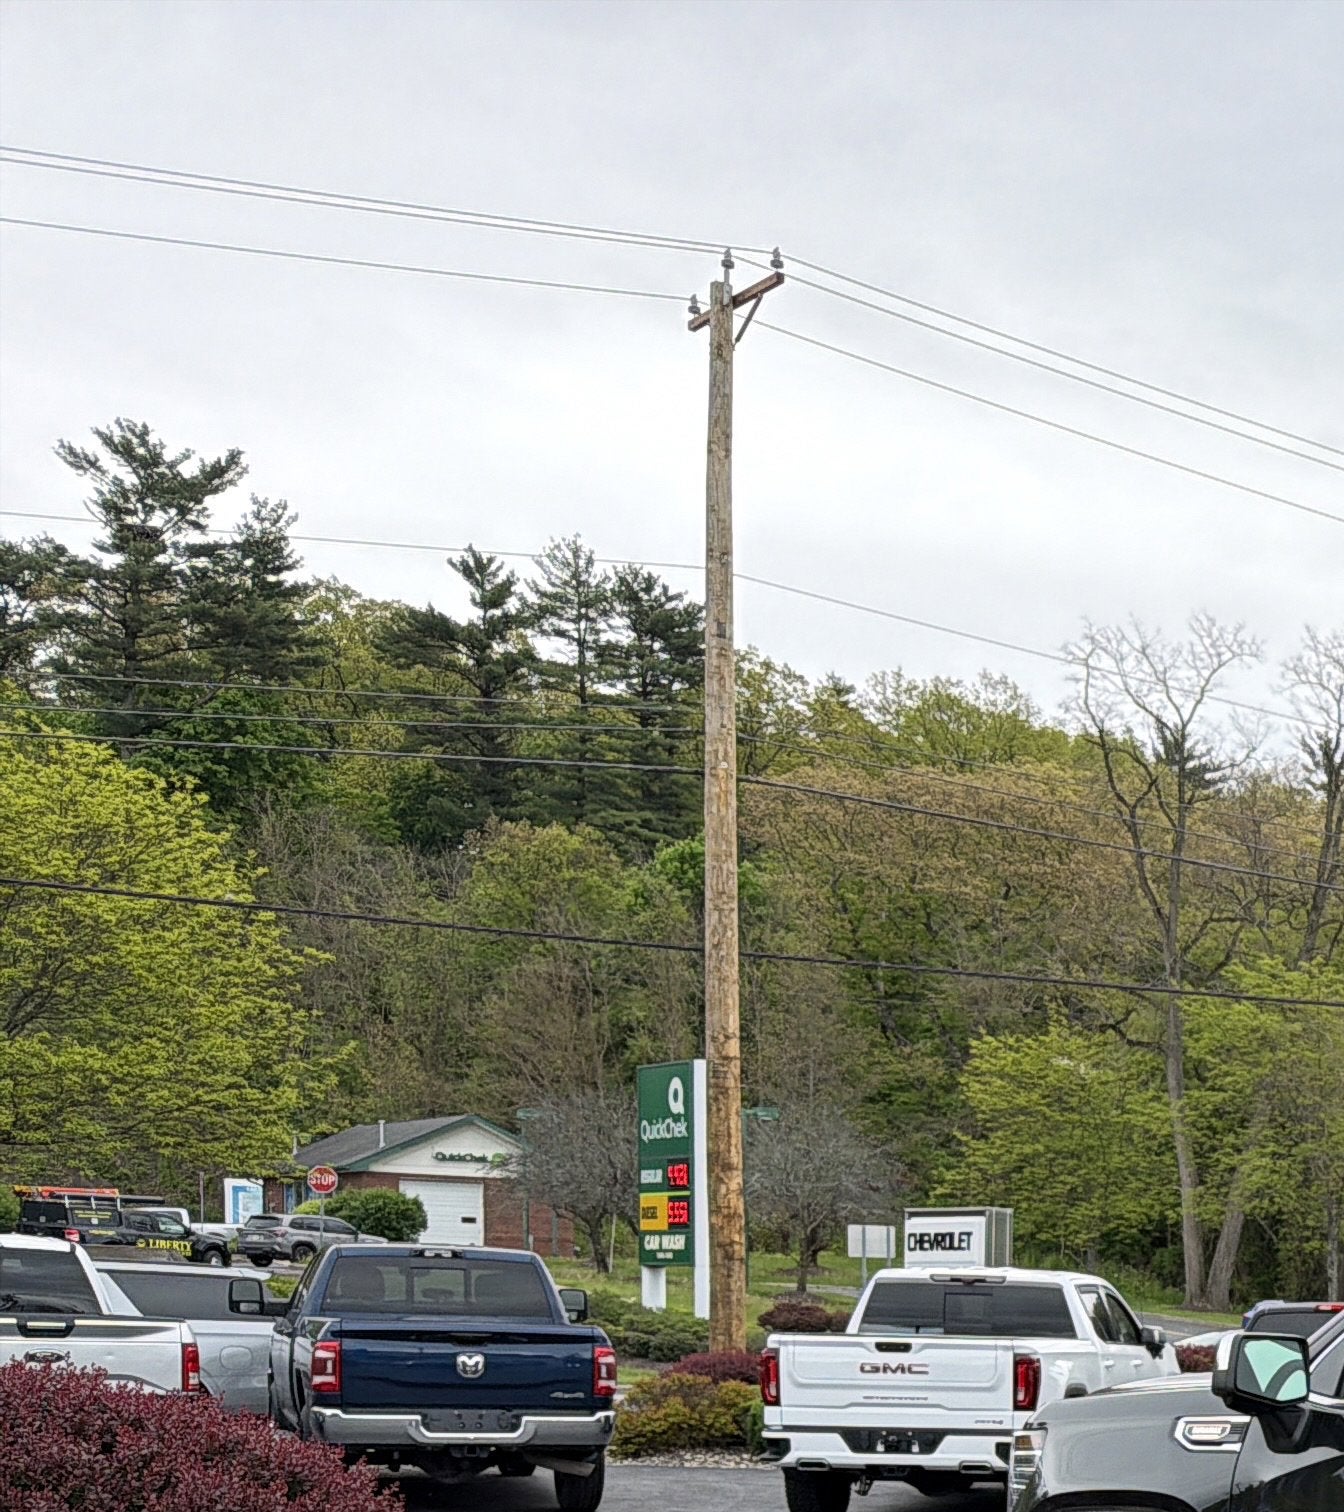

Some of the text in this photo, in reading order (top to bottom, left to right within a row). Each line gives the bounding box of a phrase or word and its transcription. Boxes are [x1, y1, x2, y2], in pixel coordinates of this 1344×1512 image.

[640, 1117, 688, 1143] QuickChek
[310, 1174, 335, 1186] STOP
[148, 1238, 193, 1252] LIBERTY
[644, 1234, 686, 1250] CAR WASH
[907, 1231, 973, 1251] CHEVROLET
[859, 1362, 930, 1375] GMC
